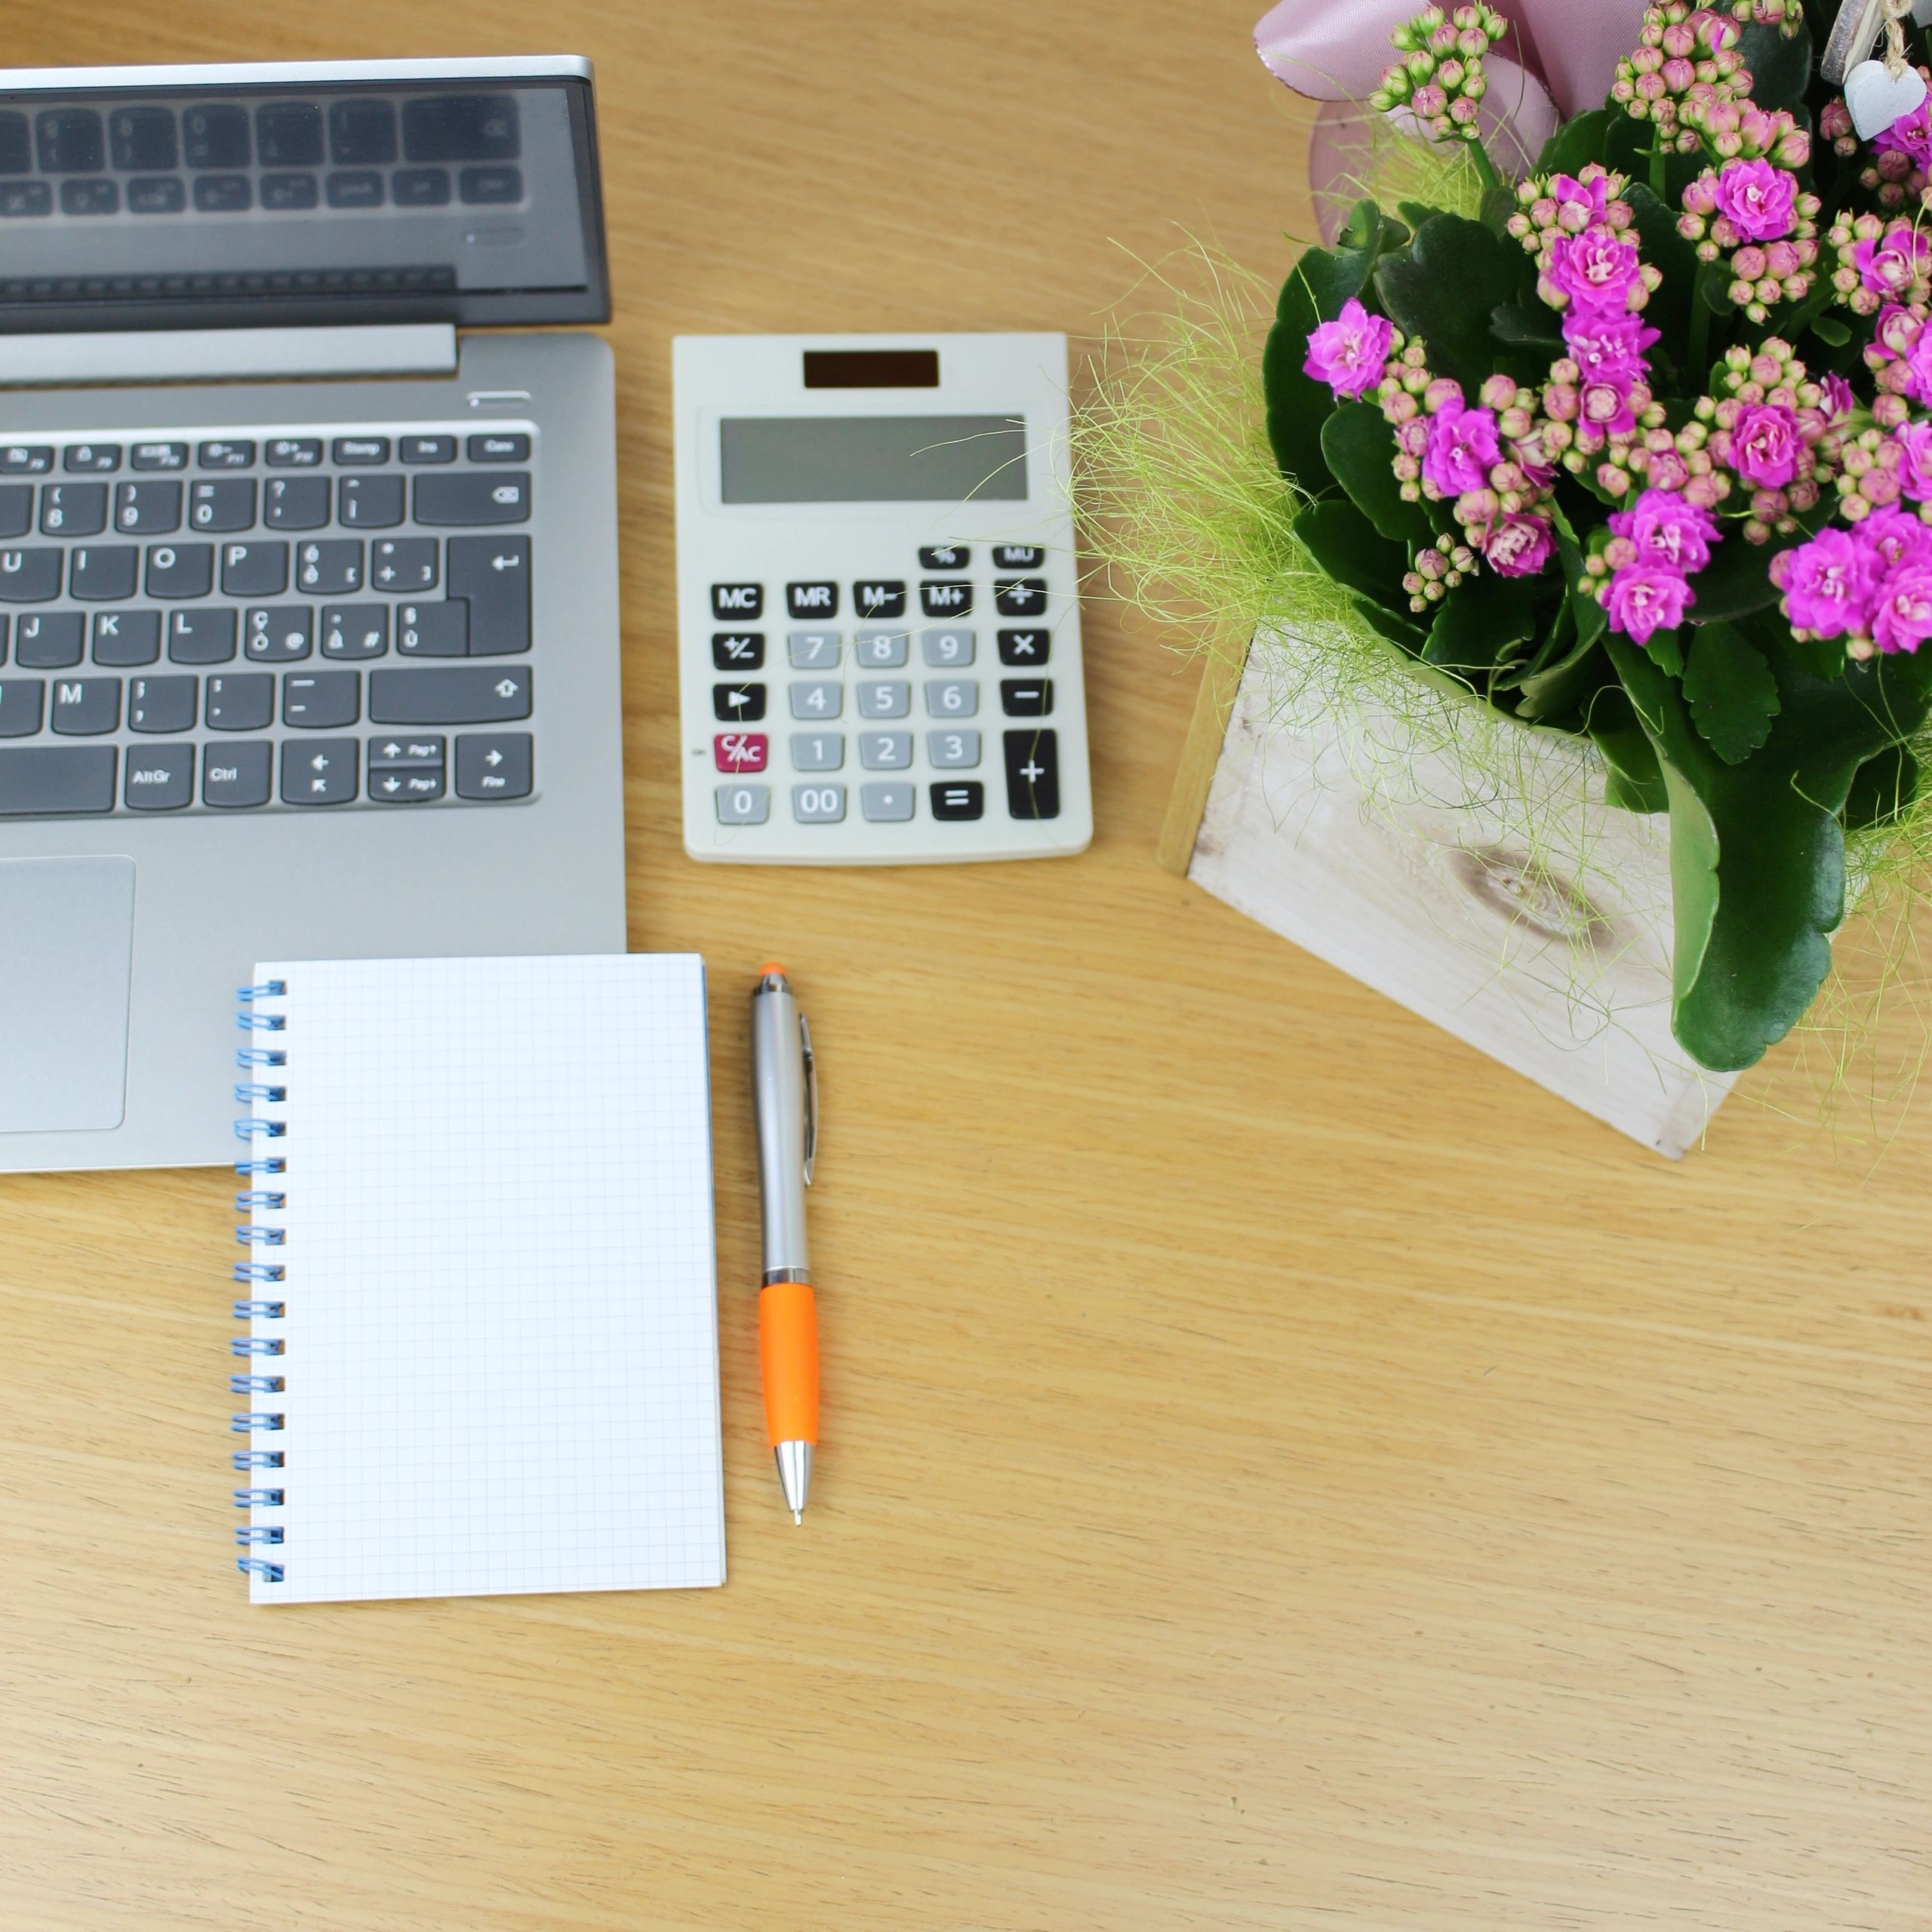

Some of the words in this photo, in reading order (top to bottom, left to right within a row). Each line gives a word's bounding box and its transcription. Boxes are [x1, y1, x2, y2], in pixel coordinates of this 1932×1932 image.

[272, 480, 286, 497] ?
[48, 508, 63, 528] 8
[122, 506, 139, 527] 9
[2, 552, 22, 573] U
[78, 550, 87, 570] I
[153, 547, 176, 569] O
[228, 546, 248, 566] P
[718, 587, 757, 608] MC
[794, 586, 831, 607] MR
[929, 586, 964, 605] M+
[24, 617, 40, 638] J
[100, 615, 119, 635] K
[176, 613, 192, 634] L
[805, 636, 824, 660] 7
[872, 635, 892, 659] 8
[939, 635, 959, 660] 9
[60, 683, 82, 704] M
[807, 687, 826, 710] 4
[875, 686, 894, 710] 5
[943, 685, 962, 710] 6
[813, 740, 823, 761] 1
[878, 737, 896, 761] 2
[945, 736, 963, 760] 3
[132, 769, 171, 784] AltGr
[209, 768, 237, 782] Ctrl
[734, 790, 752, 814] 0
[800, 789, 838, 814] 00
